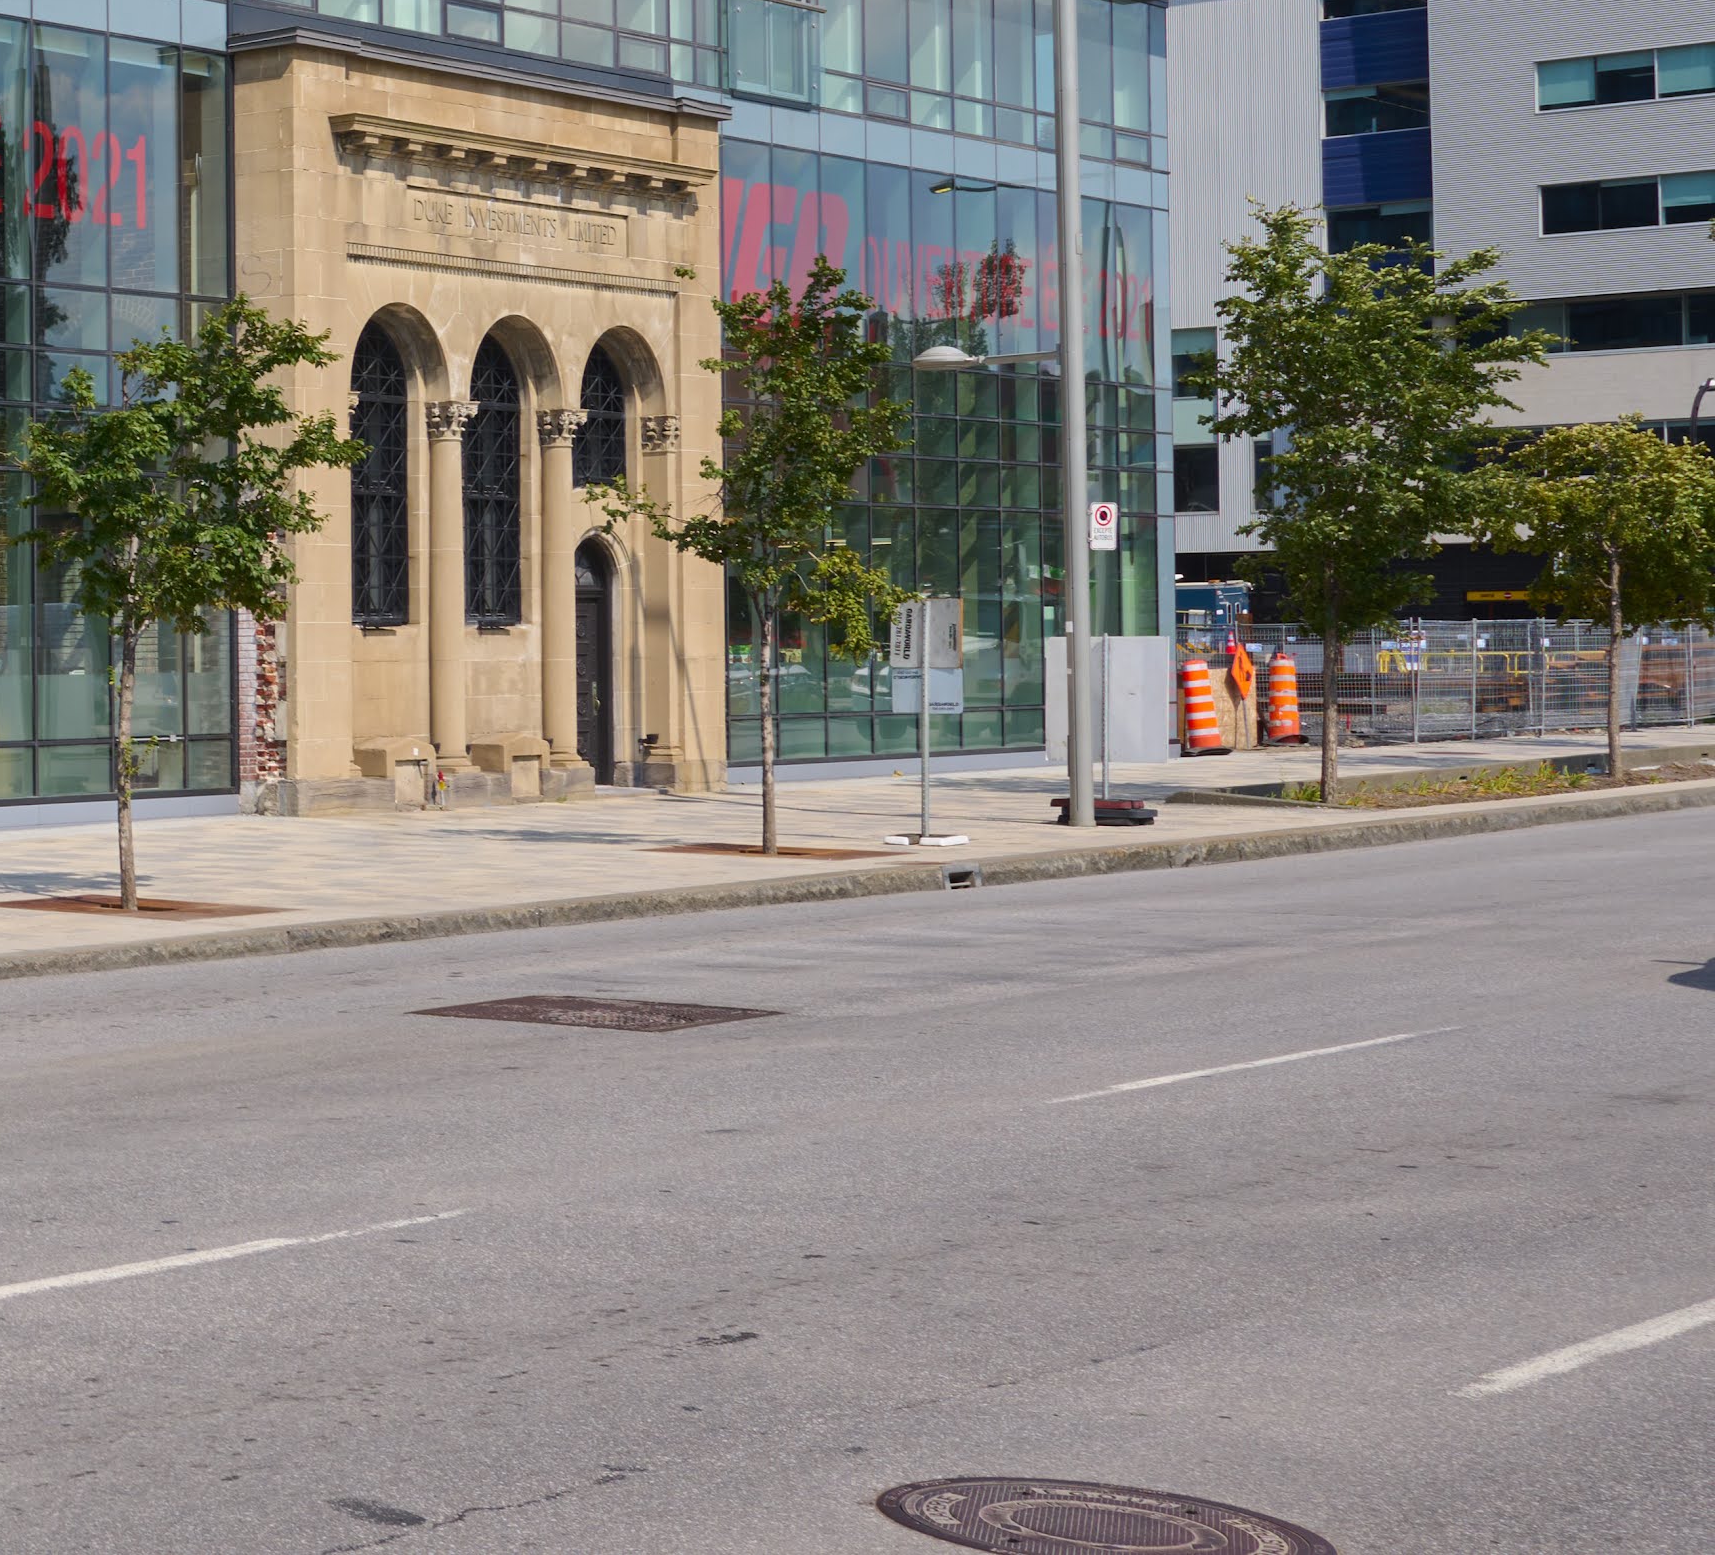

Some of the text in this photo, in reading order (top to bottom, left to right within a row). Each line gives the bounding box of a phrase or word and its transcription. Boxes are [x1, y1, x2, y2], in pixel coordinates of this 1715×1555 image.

[23, 120, 147, 230] 2021
[413, 198, 618, 246] DUKE INVESTMENTS LIMITED
